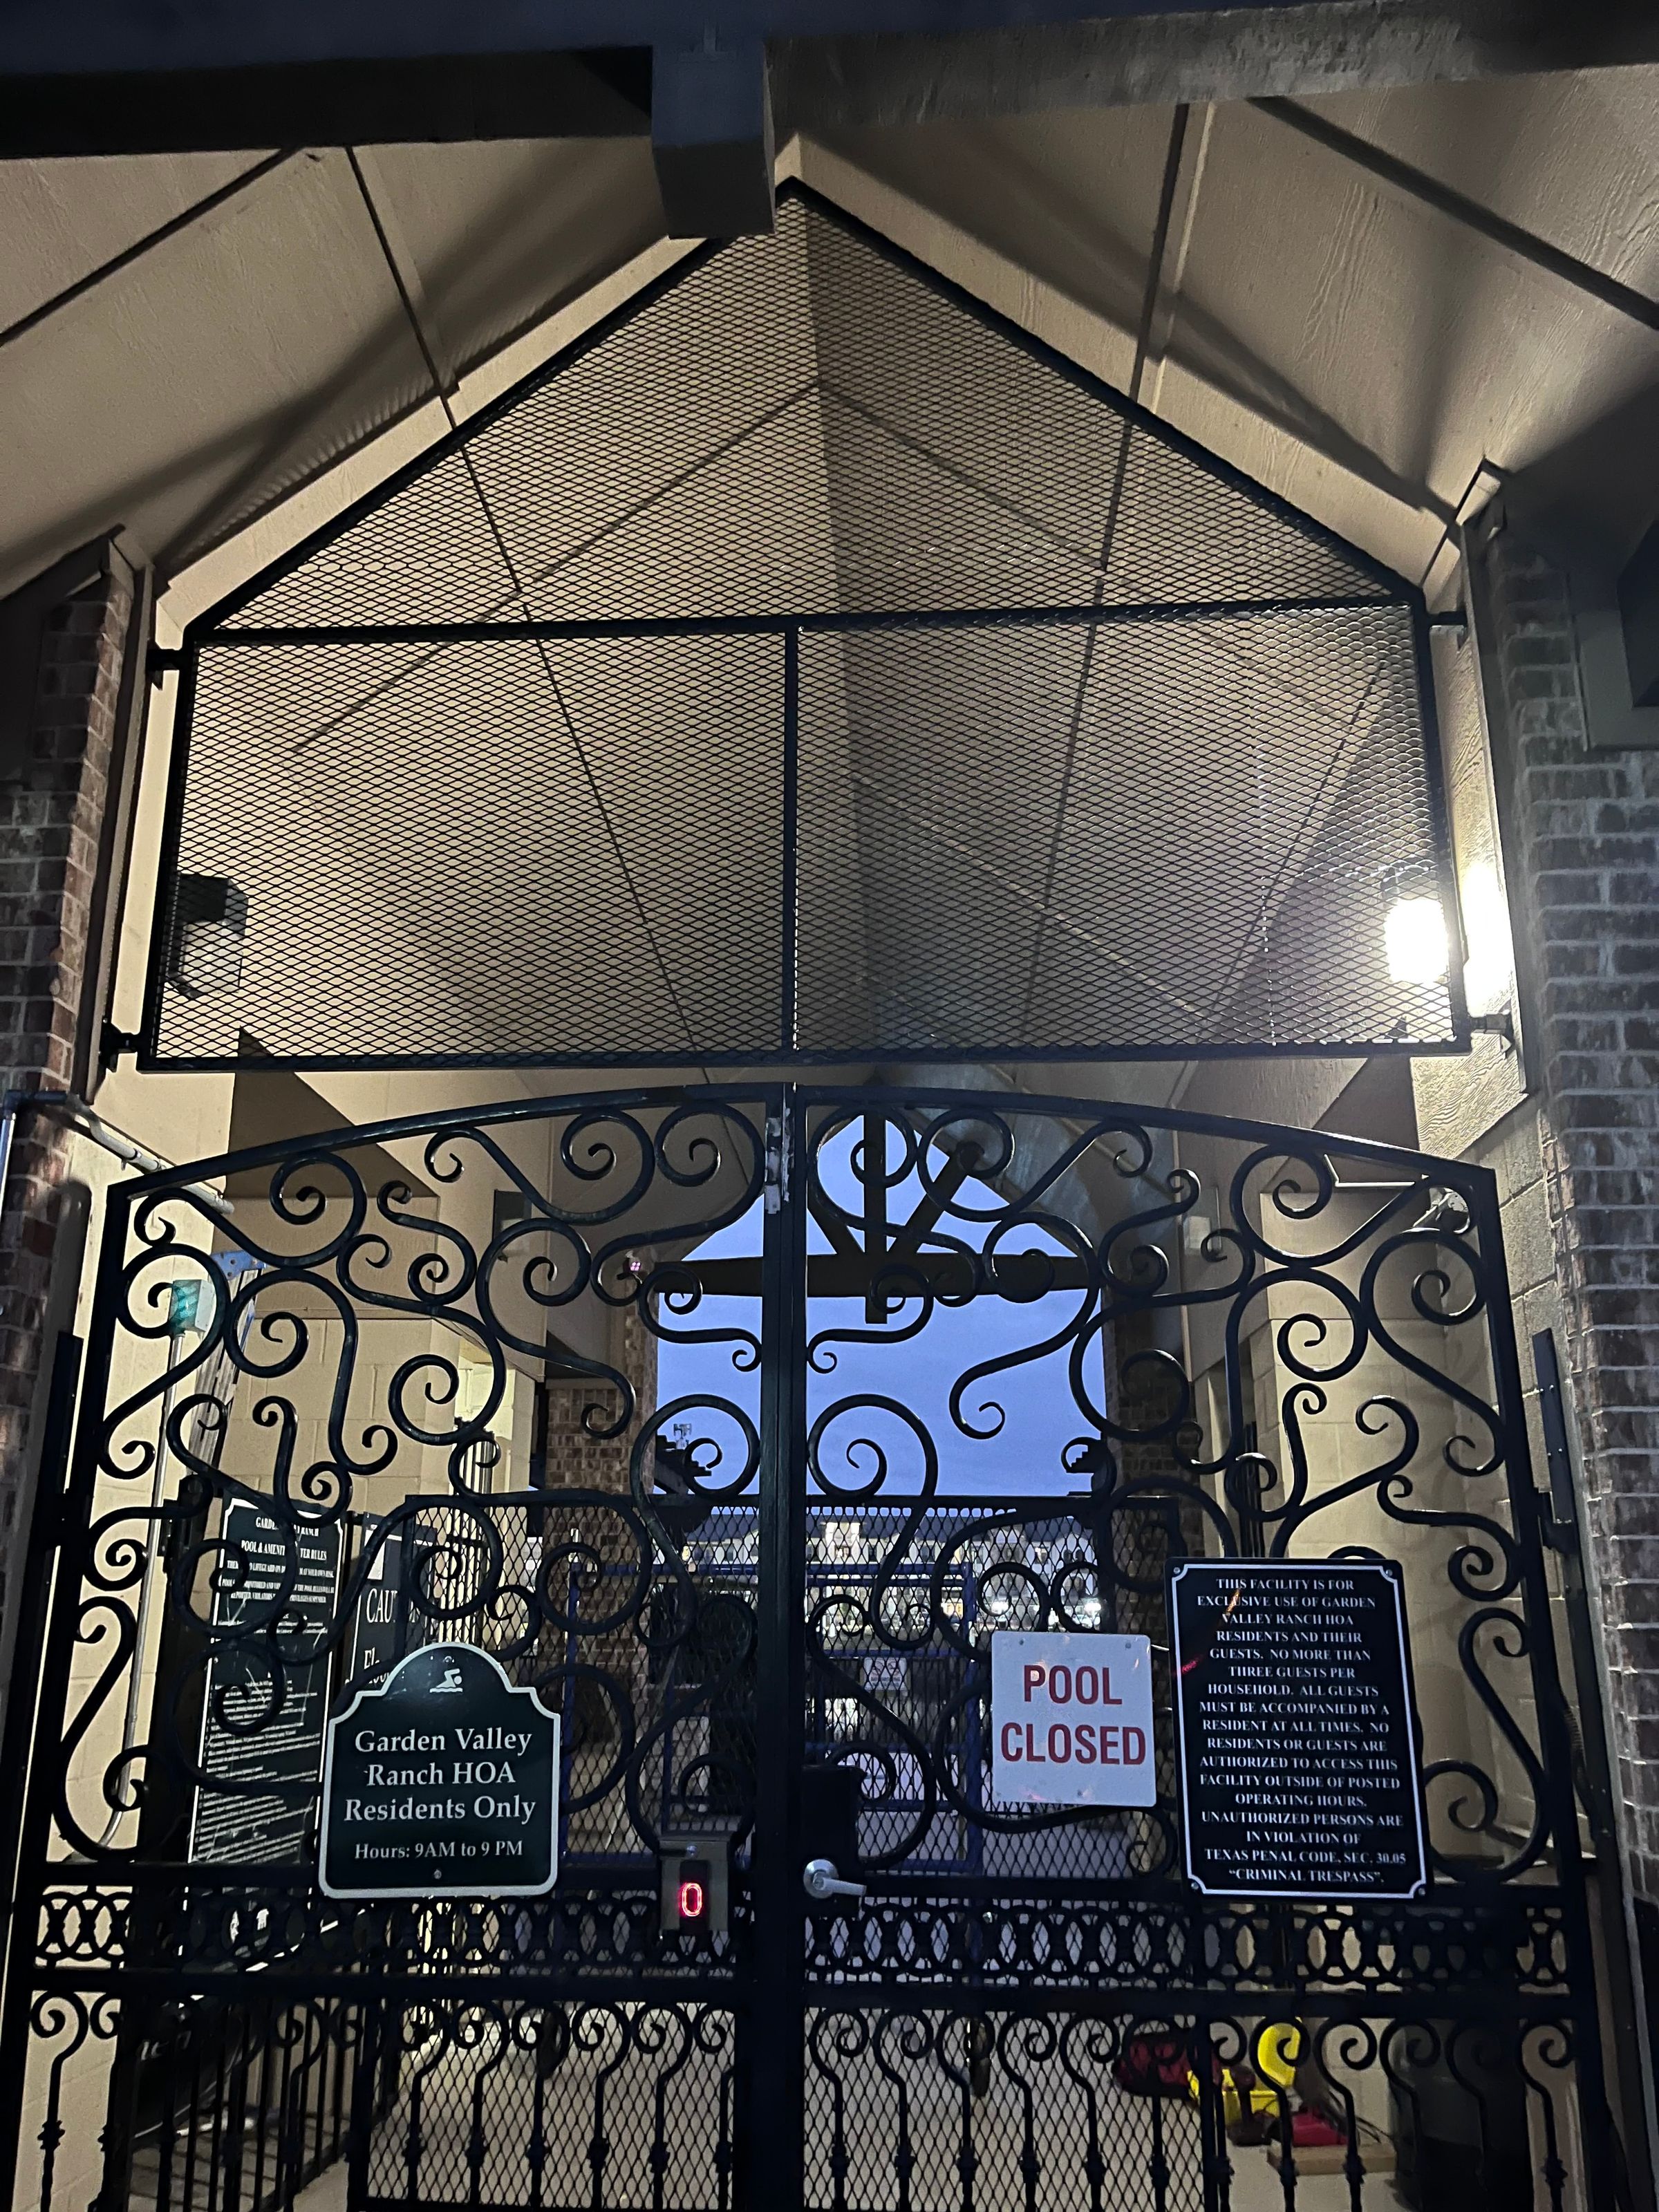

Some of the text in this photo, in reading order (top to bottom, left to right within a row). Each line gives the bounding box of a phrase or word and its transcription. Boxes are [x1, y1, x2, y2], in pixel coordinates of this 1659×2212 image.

[241, 1539, 257, 1553] POOL
[258, 1542, 263, 1553] &
[263, 1544, 285, 1556] AMENIT
[311, 1550, 327, 1561] RULES
[1217, 1579, 1354, 1590] THIS FACILITY IS FOR
[1197, 1596, 1376, 1607] EXCLUSIVE USE OF GARDEN
[1221, 1613, 1353, 1624] VALLEY RANCH HOA
[1217, 1631, 1362, 1642] RESIDENTS AND THEIR
[1210, 1649, 1371, 1660] GUESTS. NO MORE THAN
[1228, 1667, 1355, 1678] THREE GUESTS PER
[1024, 1665, 1123, 1705] POOL
[1208, 1684, 1378, 1696] HOUSEHOLD. ALL GUESTS
[1199, 1702, 1389, 1714] MUST BE ACCOMPANIED BY A
[1203, 1720, 1389, 1732] RESIDENT AT ALL TIMES. NO
[355, 1727, 532, 1756] Garden Valley
[1001, 1722, 1146, 1765] CLOSED
[1207, 1738, 1387, 1751] RESIDENTS OR GUESTS ARE
[1200, 1756, 1398, 1770] AUTHORIZED TO ACCESS THIS
[366, 1762, 516, 1785] Ranch HOA
[1200, 1774, 1400, 1788] FACILITY OUTSIDE OF POSTED
[1235, 1794, 1367, 1806] OPERATING HOURS.
[344, 1794, 536, 1824] Residents Only
[1202, 1811, 1403, 1826] UNAUTHORIZED PERSONS ARE
[1246, 1831, 1361, 1844] IN VIOLATION OF
[355, 1841, 523, 1859] Hours: 9AM to 9 PM
[1205, 1849, 1249, 1860] TEXAS
[1252, 1850, 1297, 1862] PENAL
[1376, 1853, 1406, 1864] 30.05
